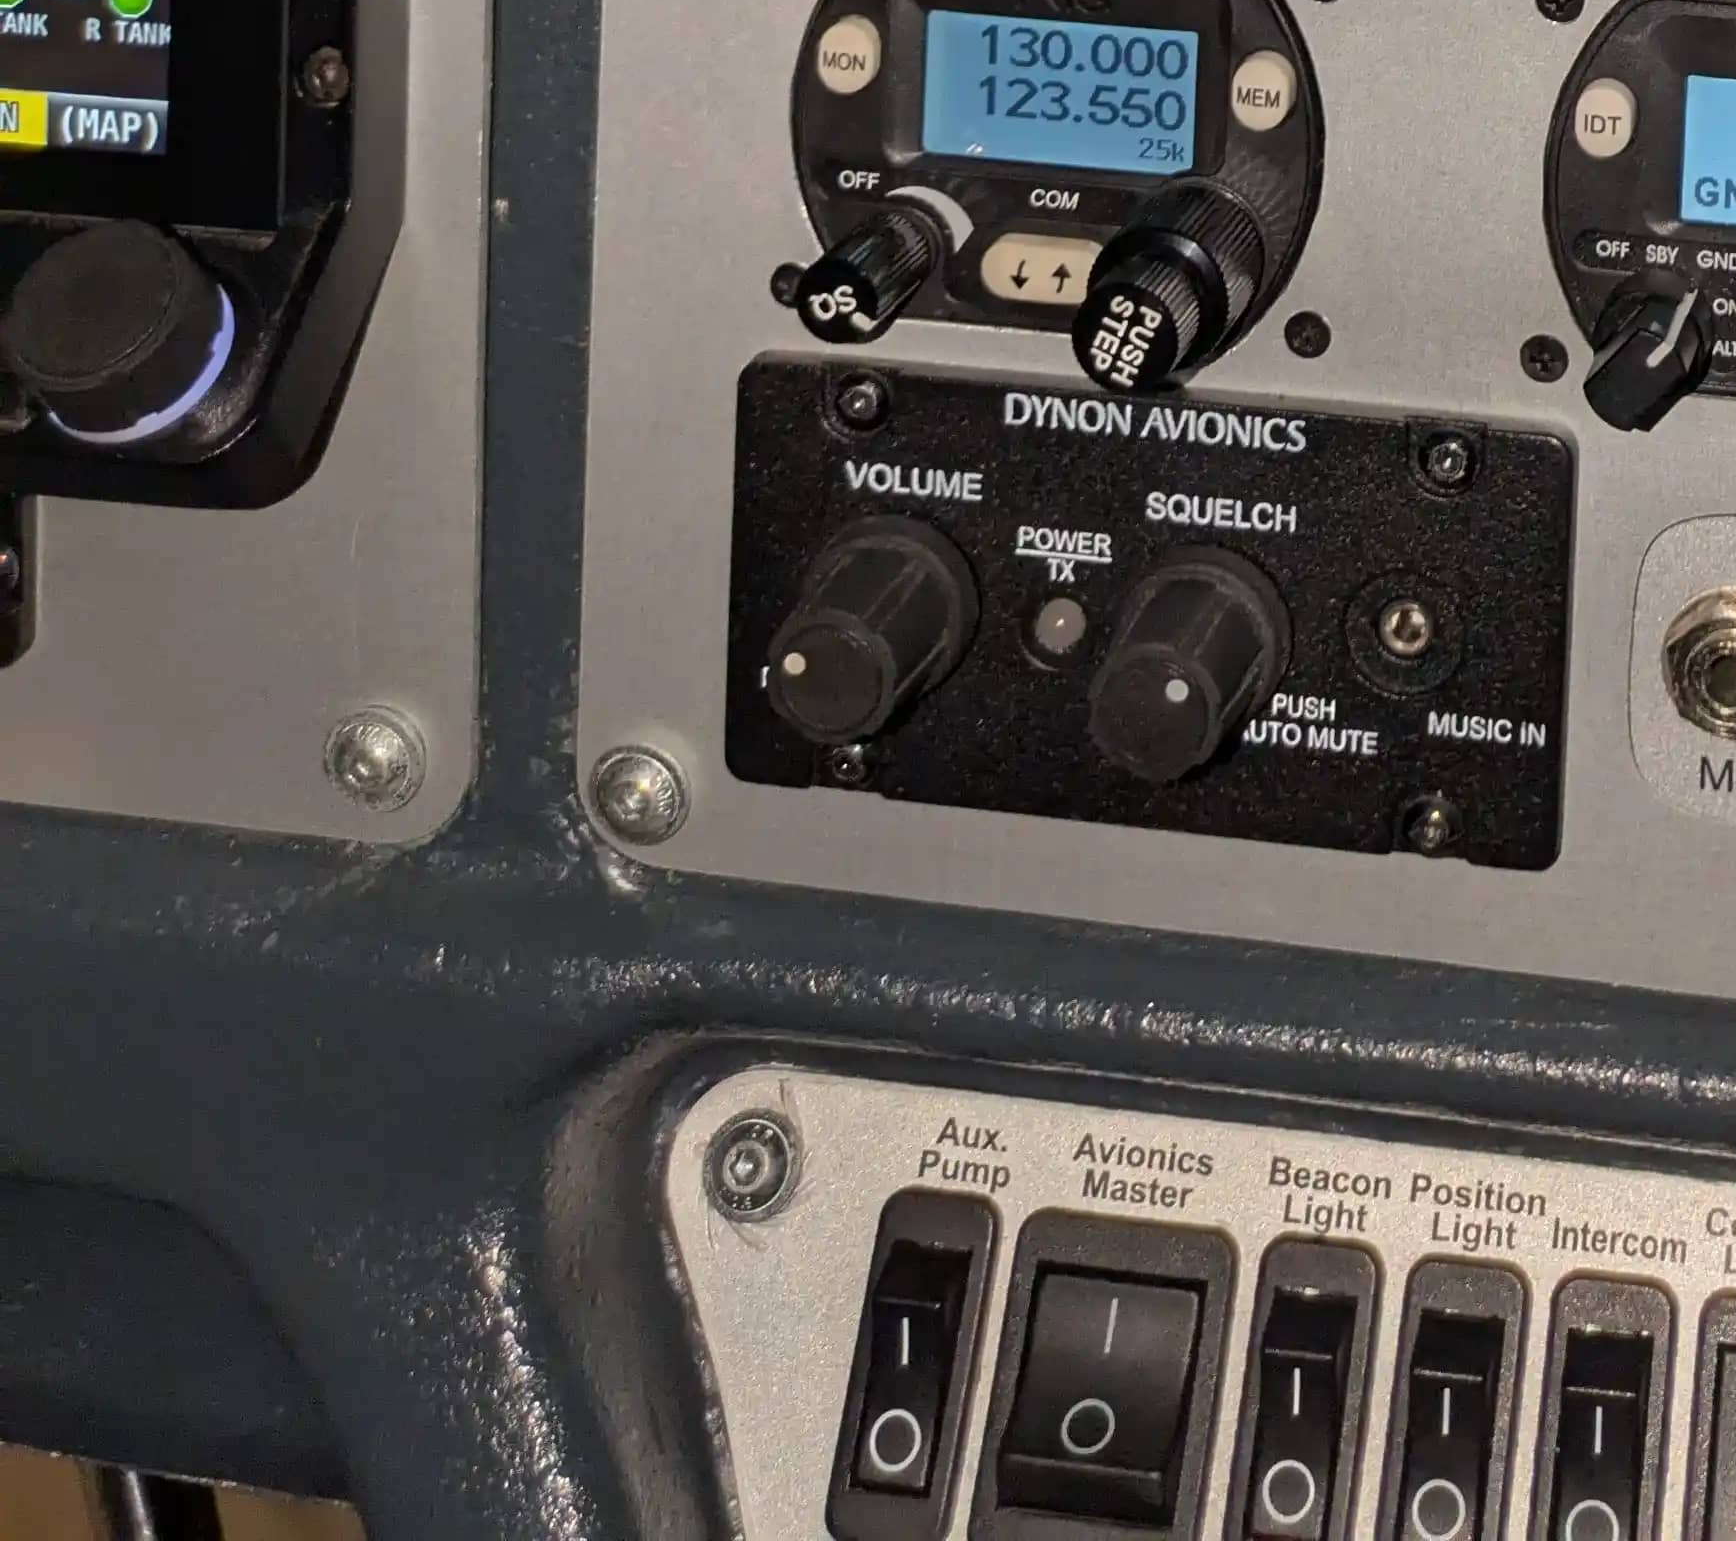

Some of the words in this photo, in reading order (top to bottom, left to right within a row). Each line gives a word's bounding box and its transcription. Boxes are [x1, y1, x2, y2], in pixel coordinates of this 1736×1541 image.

[823, 51, 866, 72] MON
[981, 25, 1189, 80] 130.000
[980, 75, 1186, 131] 123.550
[1237, 86, 1281, 108] MEM
[62, 105, 158, 153] (MAP)
[1584, 113, 1622, 135] IDT
[1138, 138, 1185, 162] 25k
[838, 170, 880, 191] OFF
[1030, 188, 1079, 211] COM
[1596, 240, 1630, 259] OFF
[1645, 244, 1679, 266] SBY
[809, 285, 857, 321] SQ
[1093, 295, 1135, 372] STEP
[1111, 305, 1162, 389] PUSH
[1004, 393, 1133, 438] DYNON
[1140, 405, 1307, 453] AVIONICS
[845, 462, 984, 501] VOLUME
[1146, 492, 1296, 533] SQUELCH
[1016, 525, 1112, 559] POWER
[1046, 555, 1076, 584] TX
[1271, 694, 1335, 721] PUSH
[1307, 726, 1379, 755] MUTE
[1428, 712, 1512, 743] MUSIC
[1520, 722, 1545, 747] IN
[936, 1118, 1008, 1153] Aux.
[918, 1151, 1011, 1189] Pump
[1073, 1134, 1214, 1176] Avionics
[1082, 1169, 1193, 1209] Master
[1268, 1157, 1392, 1201] Beacon
[1410, 1175, 1546, 1217] Position
[1283, 1194, 1368, 1235] Light
[1431, 1213, 1516, 1253] Light
[1551, 1221, 1688, 1264] Intercom
